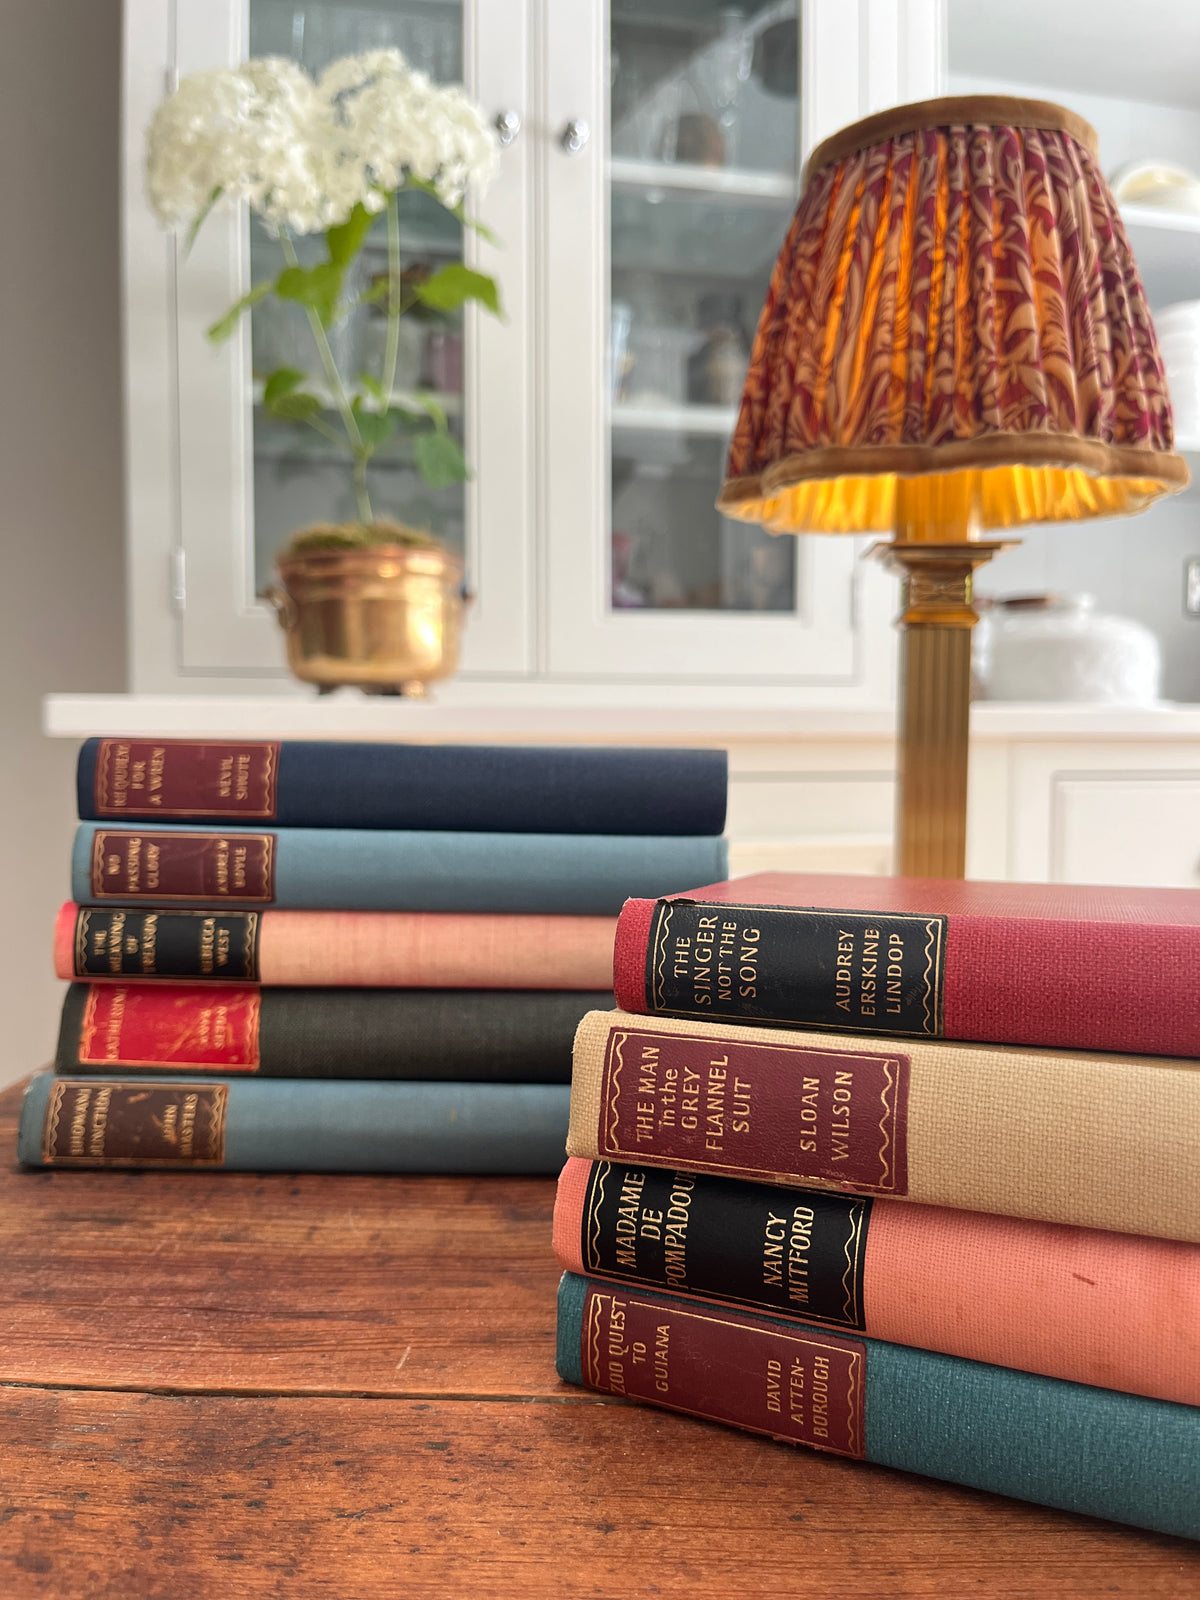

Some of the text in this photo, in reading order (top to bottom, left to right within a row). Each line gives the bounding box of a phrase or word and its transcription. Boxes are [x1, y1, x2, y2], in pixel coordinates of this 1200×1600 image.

[132, 761, 146, 789] FOR
[150, 747, 165, 805] A WREN
[108, 855, 121, 875] NO
[94, 931, 107, 955] THE
[110, 913, 126, 972] MEANING
[126, 936, 139, 953] OF
[144, 914, 158, 973] TREASON
[218, 928, 230, 966] WEST
[674, 937, 690, 977] THE
[694, 916, 718, 1005] SINGER
[718, 922, 737, 1000] NOT THE
[739, 927, 760, 998] SONG
[836, 929, 854, 1011] AUDREY
[861, 928, 879, 1016] ERSKINE
[886, 933, 904, 1014] LINDOP
[636, 1046, 660, 1142] THE MAN
[659, 1068, 678, 1127] in the
[681, 1066, 701, 1129] GREY
[706, 1055, 728, 1150] FLANNEL
[733, 1077, 751, 1133] SUIT
[800, 1077, 820, 1152] SLOAN
[831, 1071, 853, 1160] WILSON
[616, 1172, 646, 1268] MADAME
[640, 1209, 663, 1240] DE
[763, 1211, 787, 1287] NANCY
[789, 1206, 814, 1303] MITFORD
[609, 1296, 629, 1393] ZOO QUEST
[633, 1342, 646, 1364] TO
[655, 1325, 671, 1392] GUIANA
[766, 1360, 781, 1412] DAVID
[790, 1357, 804, 1424] ATTEN-
[812, 1356, 829, 1437] BOROUGH
